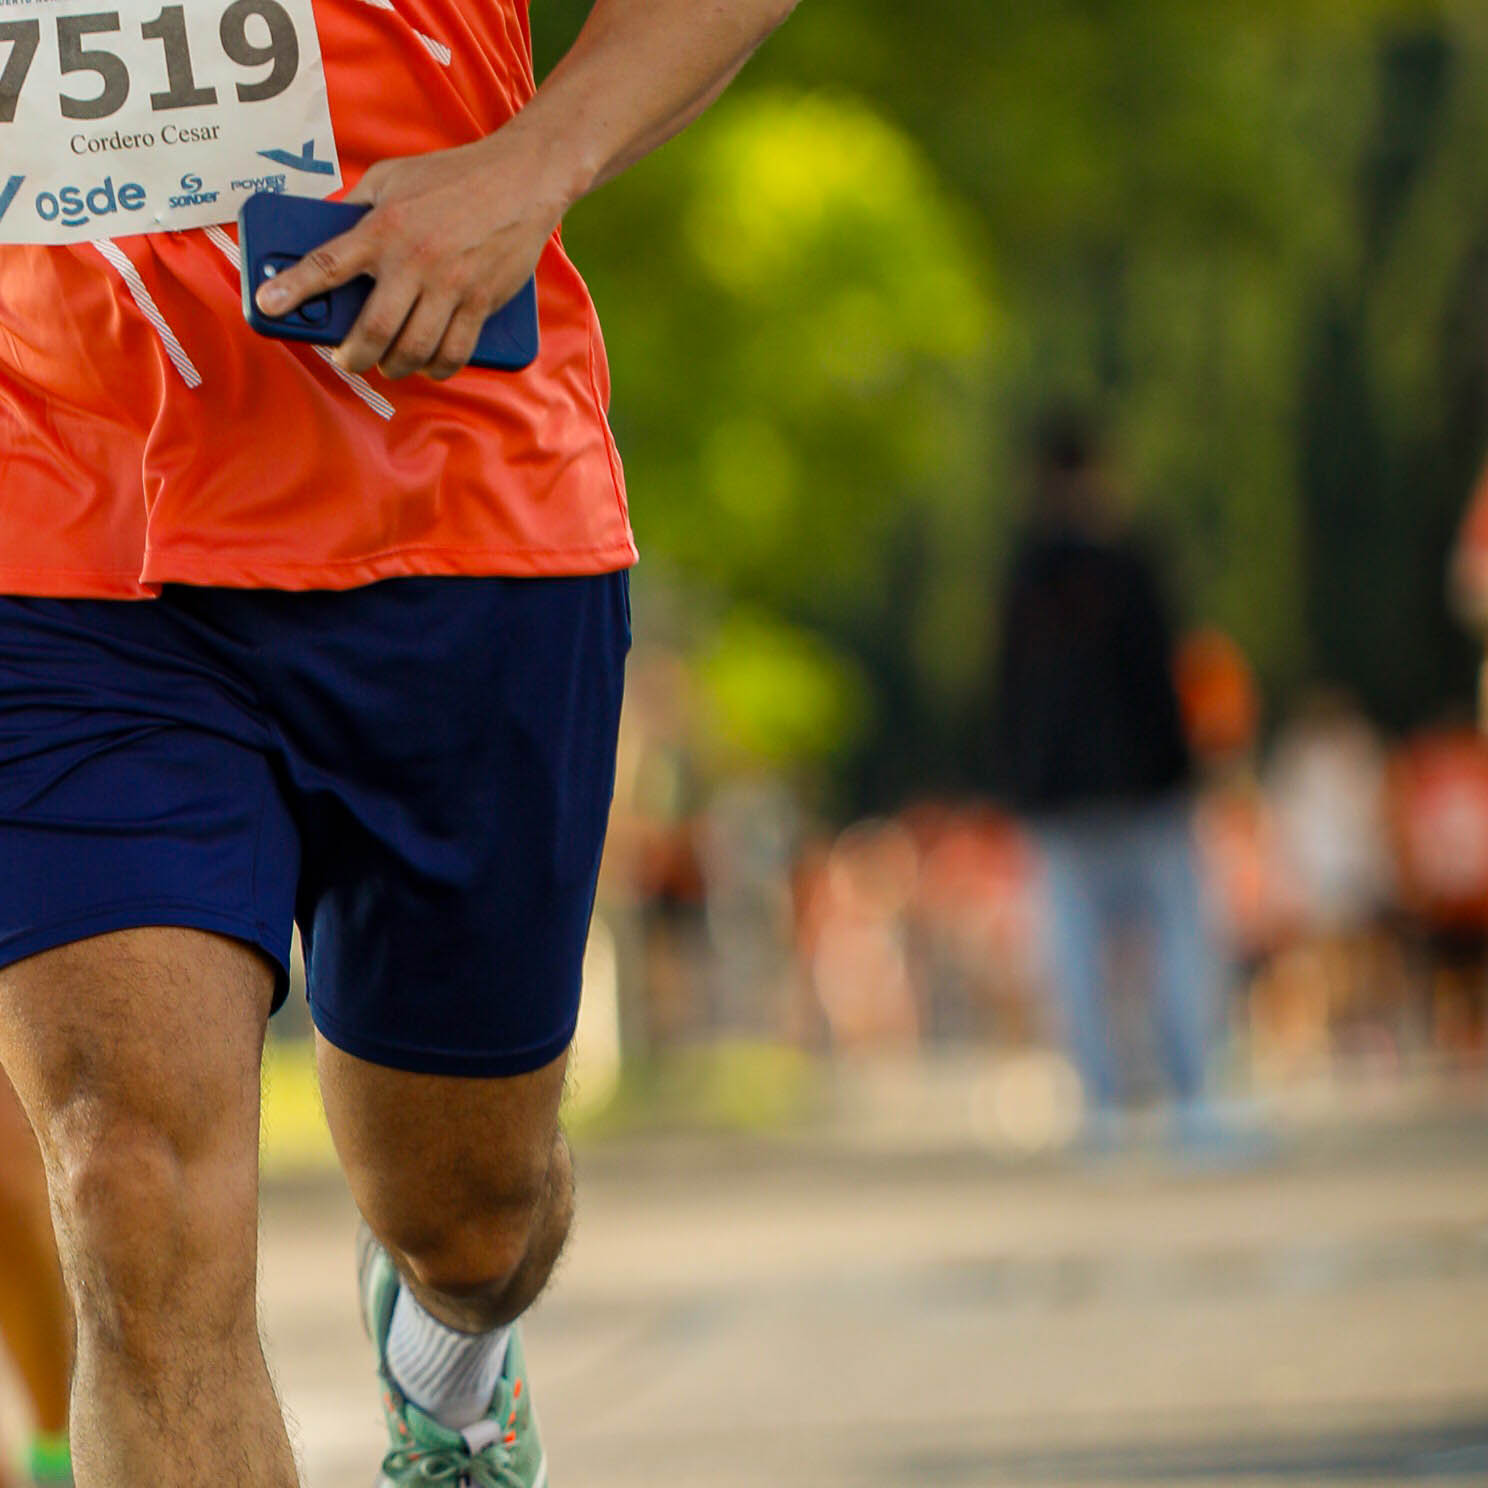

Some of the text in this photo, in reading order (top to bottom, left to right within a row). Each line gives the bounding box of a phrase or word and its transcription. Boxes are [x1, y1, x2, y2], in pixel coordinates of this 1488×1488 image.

[70, 124, 220, 155] Cordero Cesar
[36, 176, 147, 222] osde
